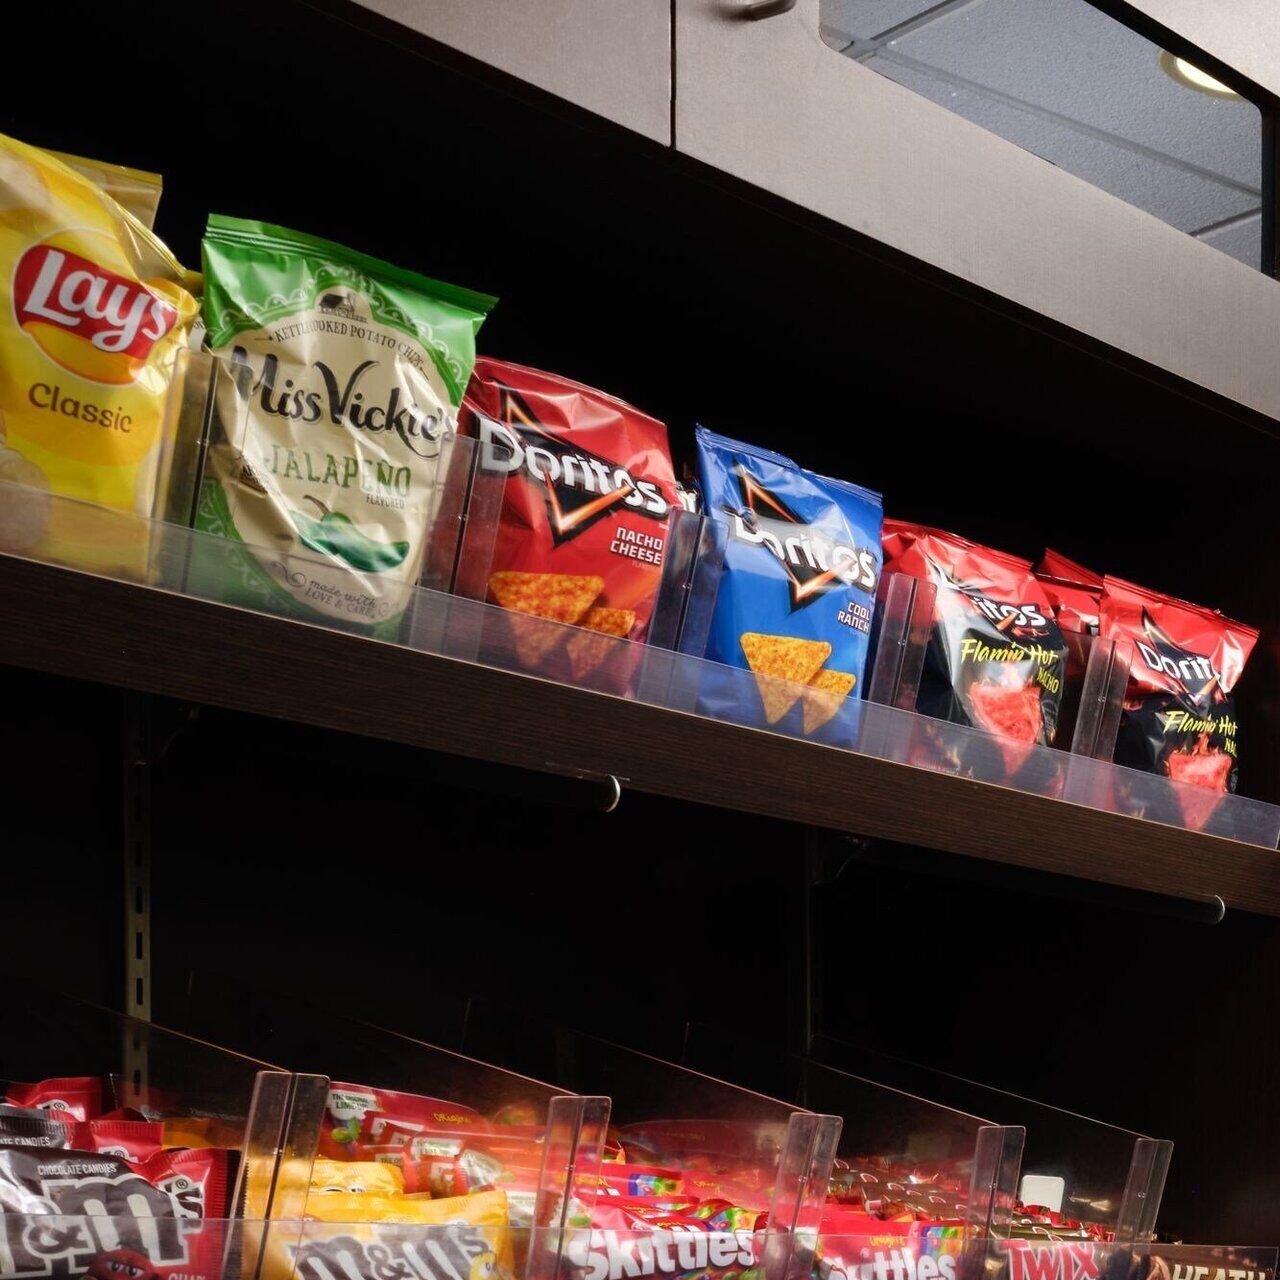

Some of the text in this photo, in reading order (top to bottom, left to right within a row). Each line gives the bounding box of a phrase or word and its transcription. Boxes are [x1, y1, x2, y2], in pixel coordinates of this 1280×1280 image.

[350, 324, 396, 348] POTATO
[230, 345, 322, 425] Miss
[28, 382, 132, 433] Classic
[481, 417, 668, 516] Doritos
[366, 494, 405, 509] FLAVORED
[617, 527, 664, 551] NACHO
[610, 540, 663, 565] CHEESE
[305, 588, 333, 605] LOVE
[309, 579, 377, 609] made with
[837, 611, 869, 632] RANCH
[848, 602, 870, 620] COOL
[1030, 646, 1058, 664] Hot
[1136, 641, 1221, 680] Dorit
[1037, 669, 1059, 694] NACHO
[1218, 716, 1238, 737] Hot
[15, 1136, 51, 1147] CANDIES
[37, 1163, 118, 1176] CHOCOLATE CANDIES
